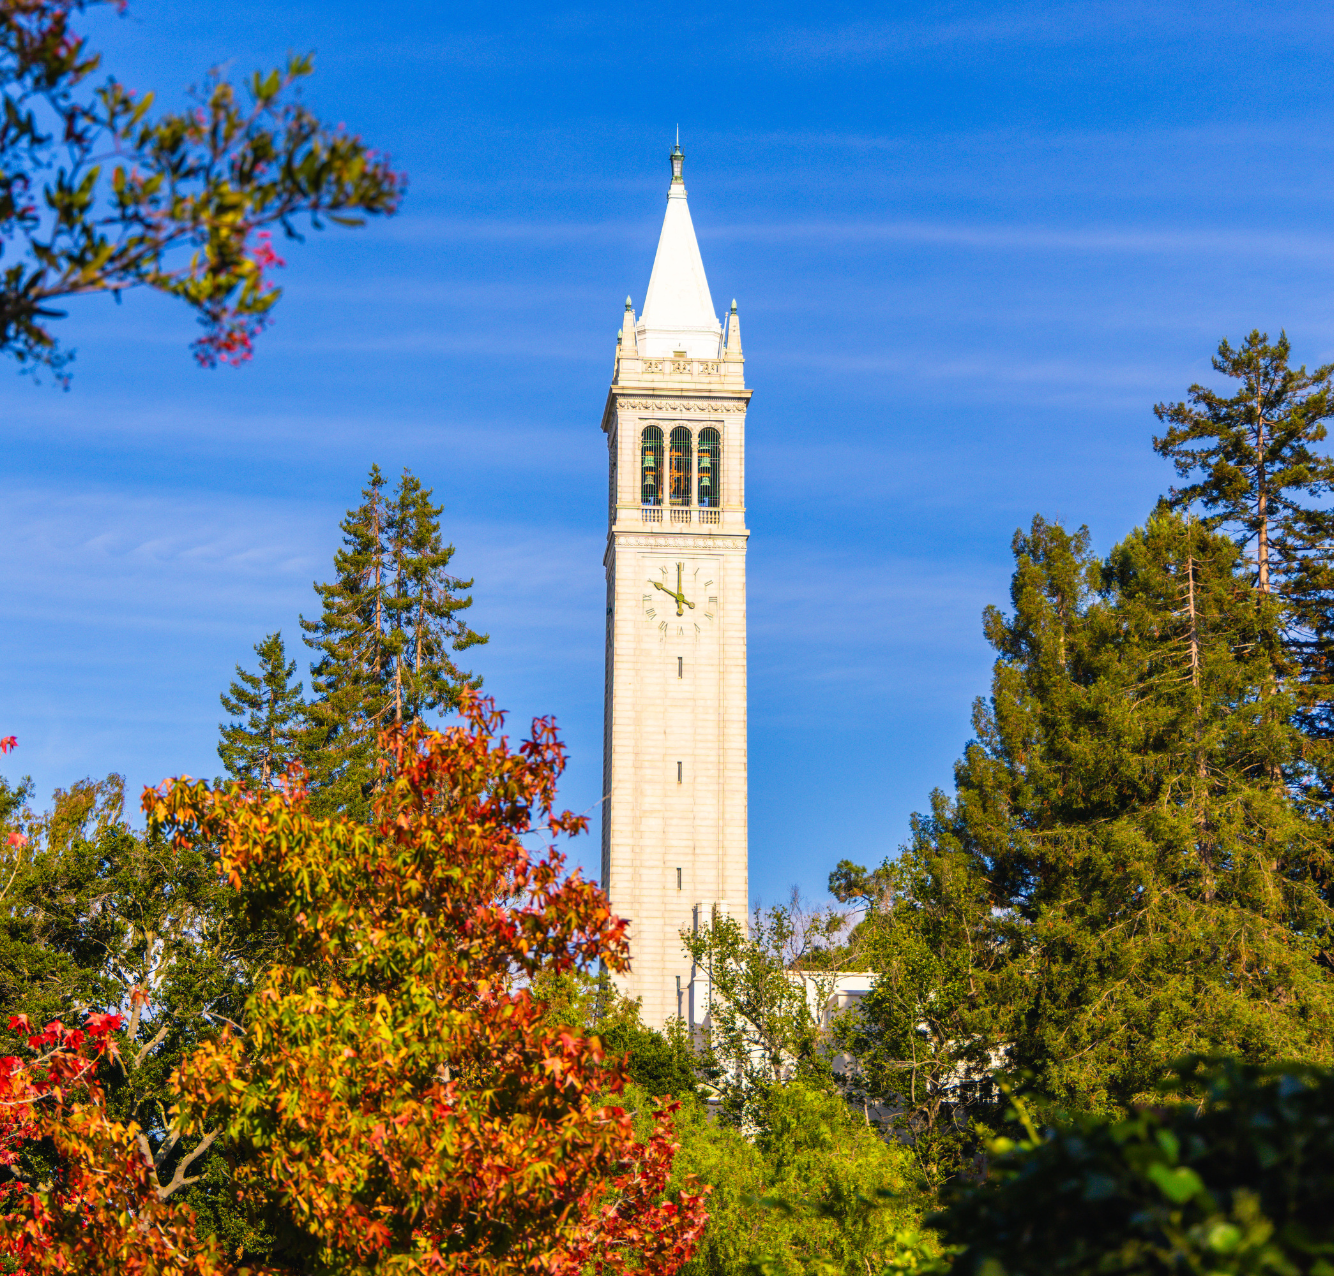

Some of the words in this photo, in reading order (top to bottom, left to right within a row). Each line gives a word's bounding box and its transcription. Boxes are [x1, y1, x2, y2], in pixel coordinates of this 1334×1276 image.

[645, 607, 657, 620] VIII
[658, 620, 668, 632] VII
[676, 626, 684, 635] VI
